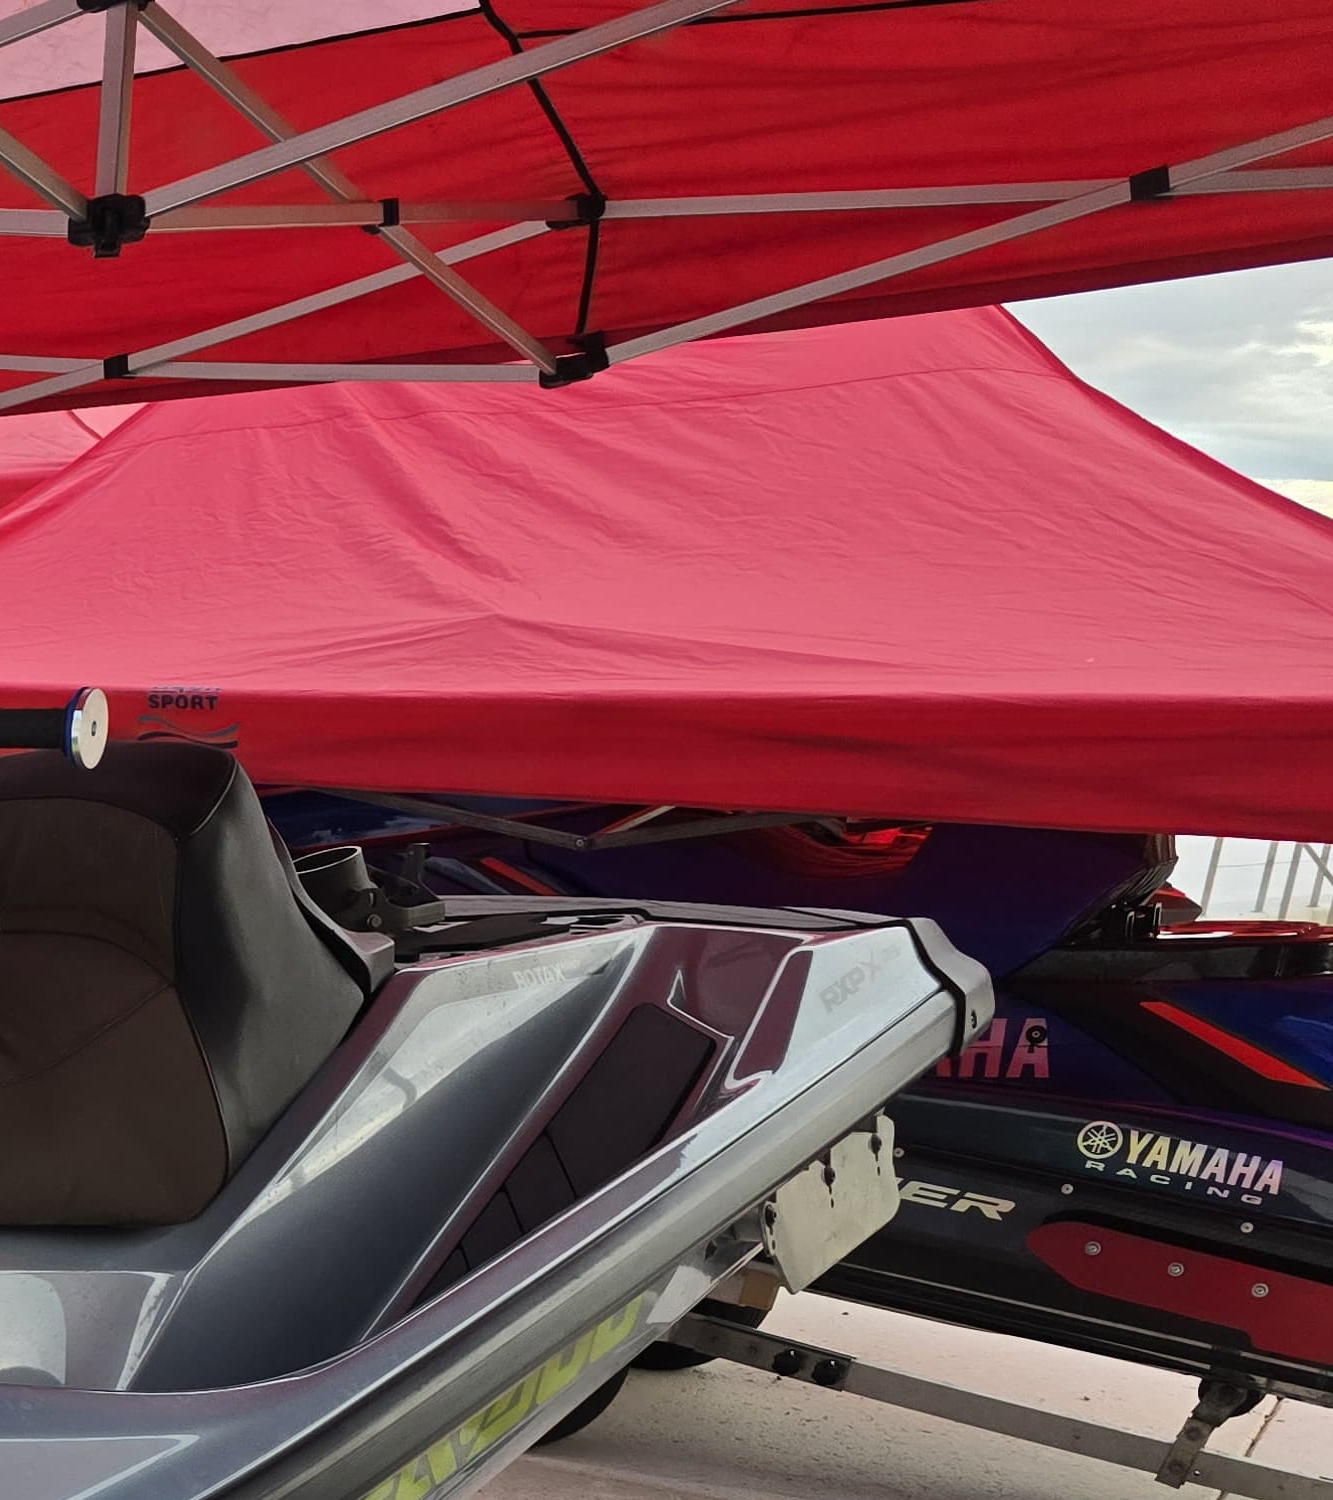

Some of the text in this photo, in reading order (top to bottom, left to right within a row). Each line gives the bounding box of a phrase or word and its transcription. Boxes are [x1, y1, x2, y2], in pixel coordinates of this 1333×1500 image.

[148, 694, 218, 710] SPORT
[1085, 1160, 1263, 1206] RACING
[1126, 1129, 1284, 1195] YAMAHA
